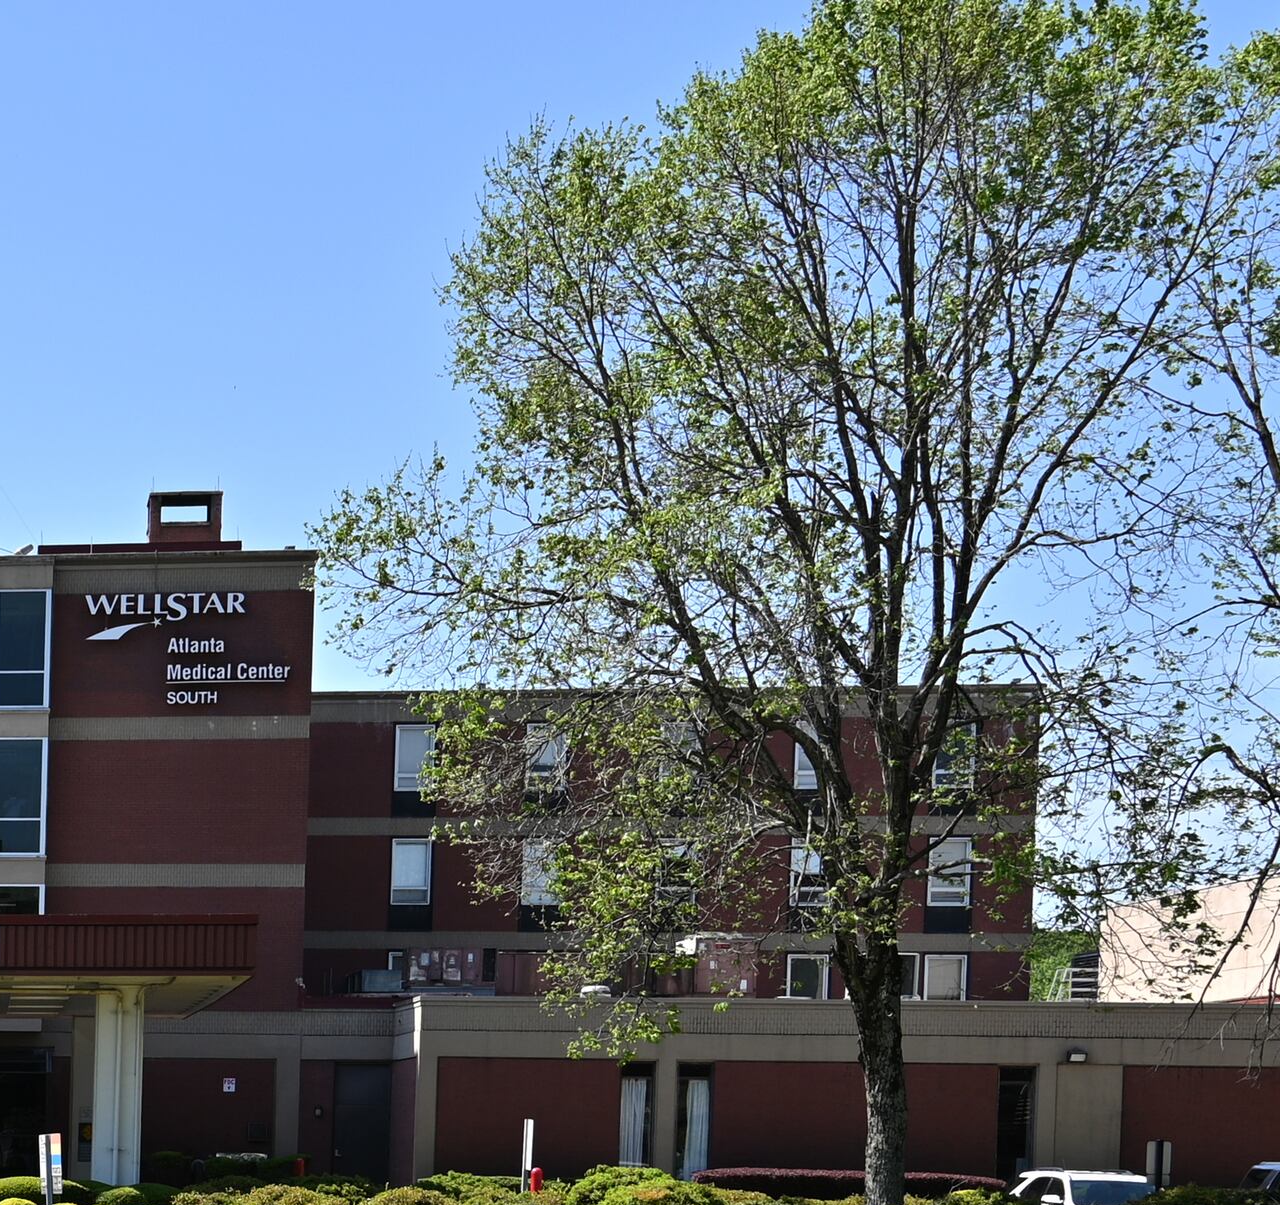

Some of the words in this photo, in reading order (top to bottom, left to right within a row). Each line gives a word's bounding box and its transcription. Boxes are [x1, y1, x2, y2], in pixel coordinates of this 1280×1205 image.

[85, 592, 246, 621] WELLSTAR
[167, 637, 225, 653] Atlanta
[166, 663, 232, 680] Medical
[237, 663, 290, 680] Center
[166, 691, 218, 704] SOUTH
